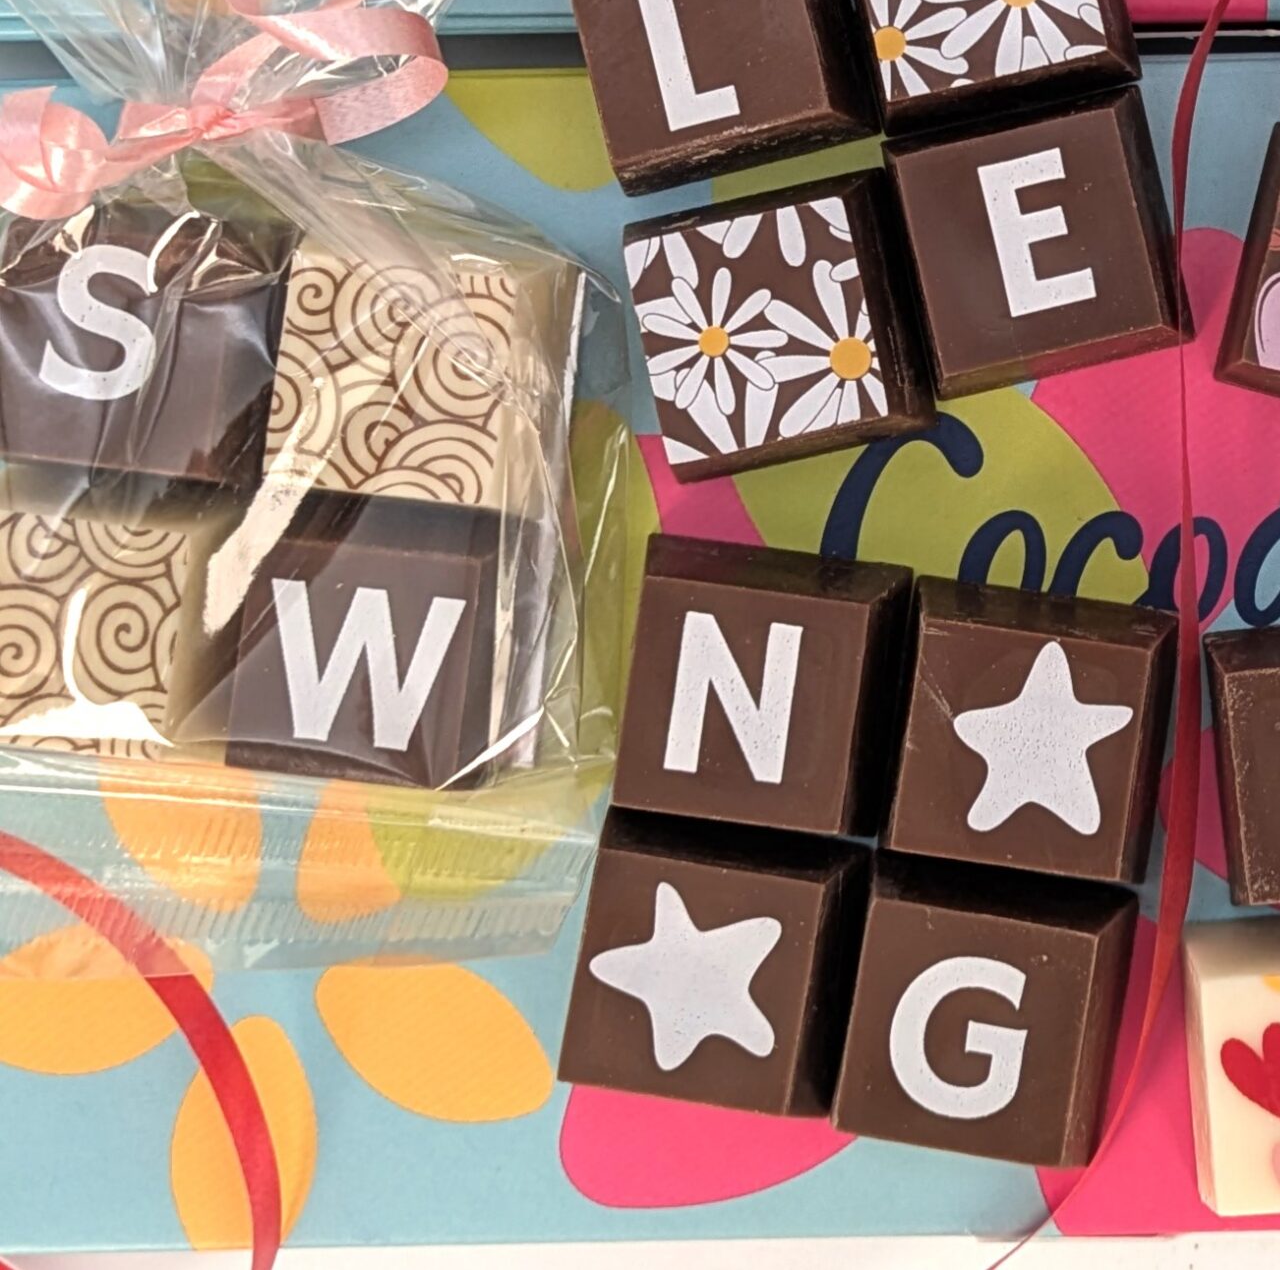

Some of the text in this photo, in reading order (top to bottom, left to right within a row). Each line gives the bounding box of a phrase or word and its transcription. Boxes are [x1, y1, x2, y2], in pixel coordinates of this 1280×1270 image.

[977, 148, 1096, 317] E
[39, 244, 157, 400] S
[272, 578, 466, 751] W
[664, 610, 802, 784] N
[890, 956, 1027, 1119] G
